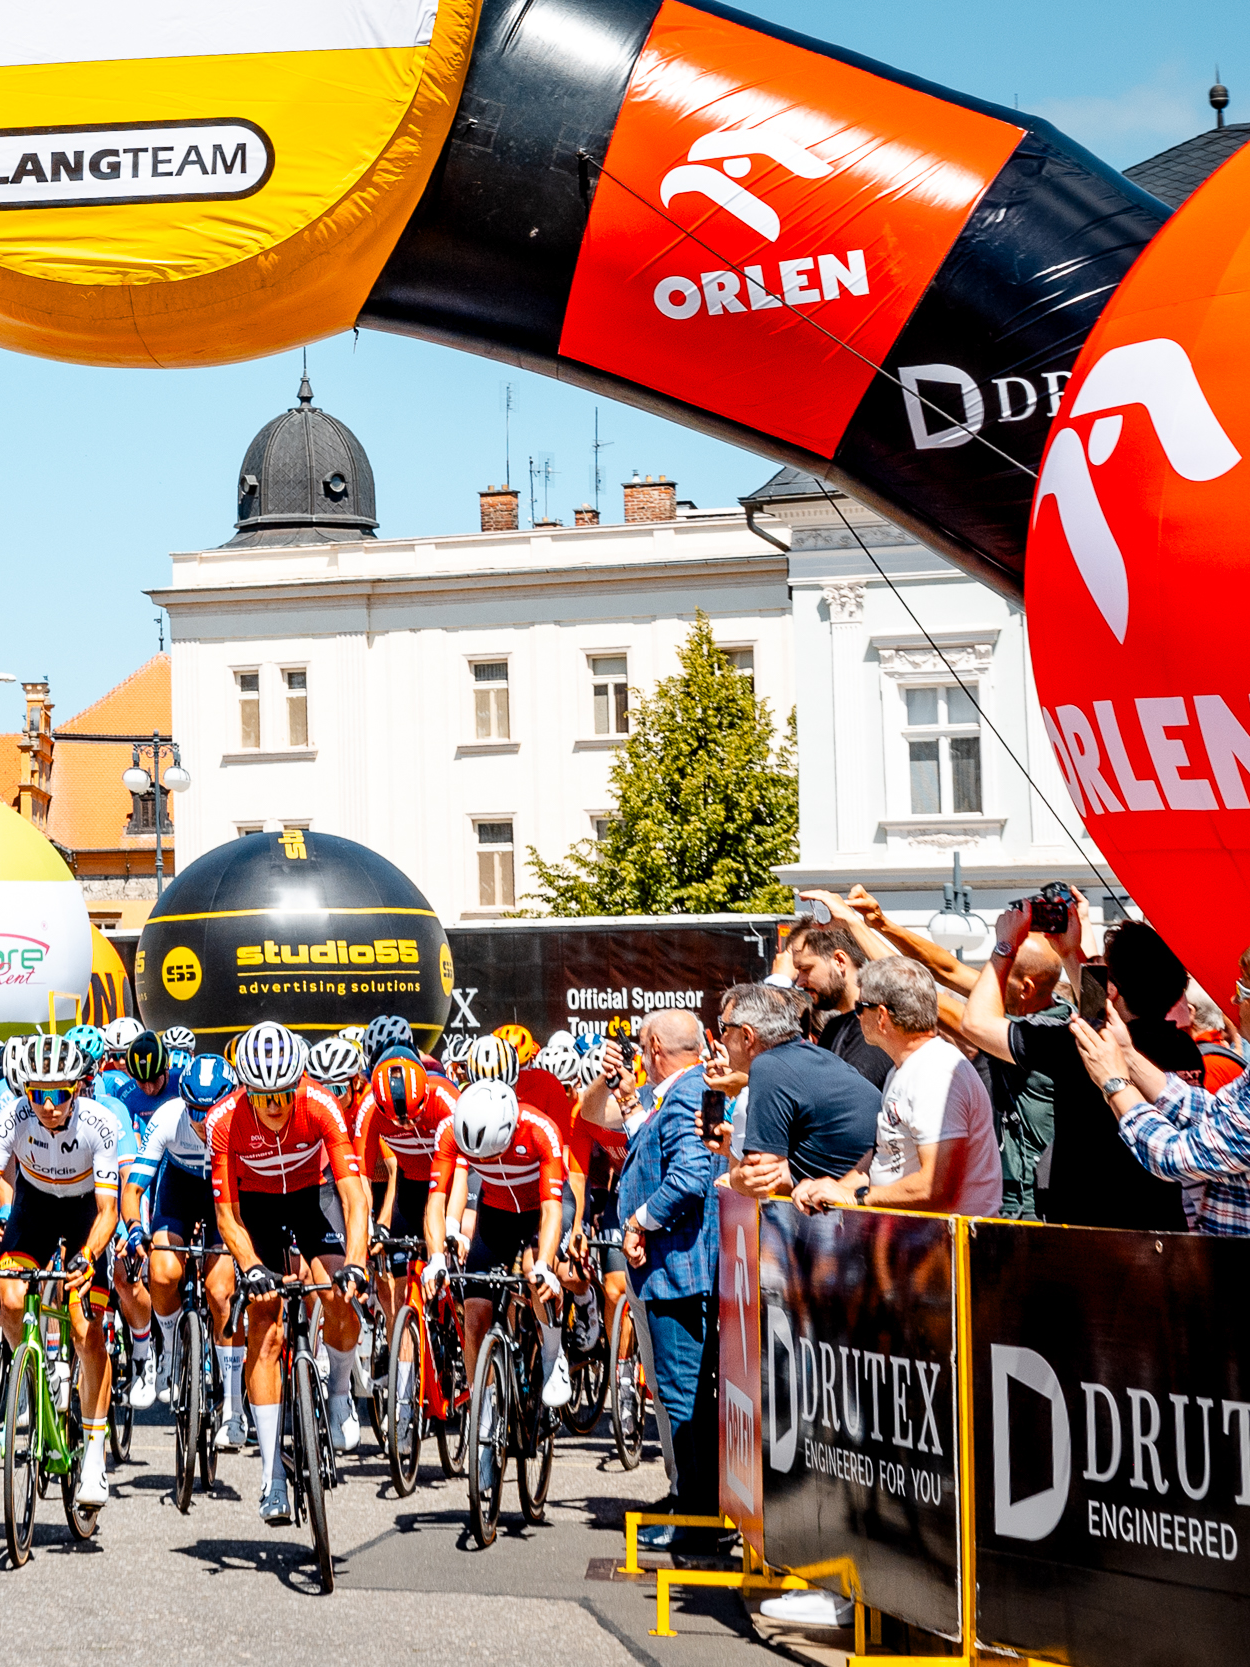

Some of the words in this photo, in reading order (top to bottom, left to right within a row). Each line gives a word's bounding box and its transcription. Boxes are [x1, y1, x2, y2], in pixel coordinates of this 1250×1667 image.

[653, 249, 870, 321] ORLEN
[236, 939, 419, 966] studio55
[239, 980, 346, 996] advertising
[351, 979, 420, 993] solutions
[567, 986, 628, 1011] Official
[632, 988, 704, 1014] Sponsor
[78, 1109, 114, 1150] Cofidis
[306, 1085, 347, 1133] postnord
[521, 1109, 562, 1158] postnord
[32, 1163, 77, 1176] Cofidis
[799, 1336, 944, 1456] DRUTEX
[804, 1437, 874, 1489] ENGINEERED
[879, 1457, 906, 1497] FOR
[910, 1466, 943, 1505] YOU
[1087, 1500, 1238, 1562] ENGINEERED
